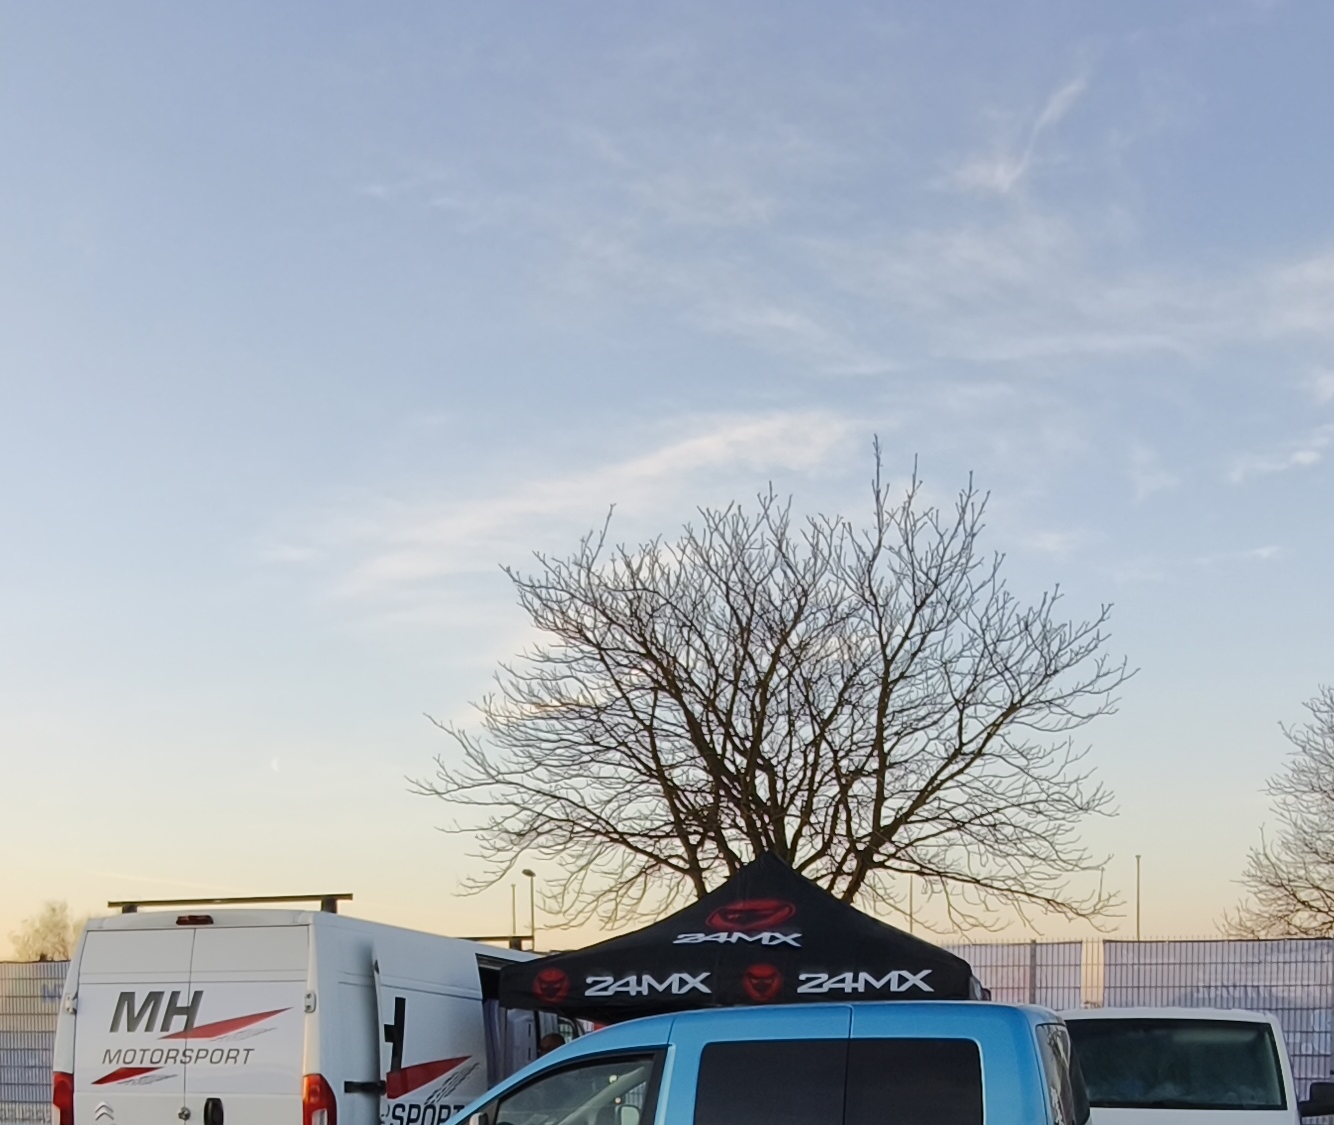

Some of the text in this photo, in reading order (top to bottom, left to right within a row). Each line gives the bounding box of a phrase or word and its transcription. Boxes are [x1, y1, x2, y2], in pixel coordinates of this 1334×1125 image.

[673, 931, 803, 948] 24MX
[584, 971, 712, 996] 24MX
[797, 969, 935, 994] 24MX
[109, 990, 204, 1033] MH
[102, 1047, 255, 1065] MOTORSPORT
